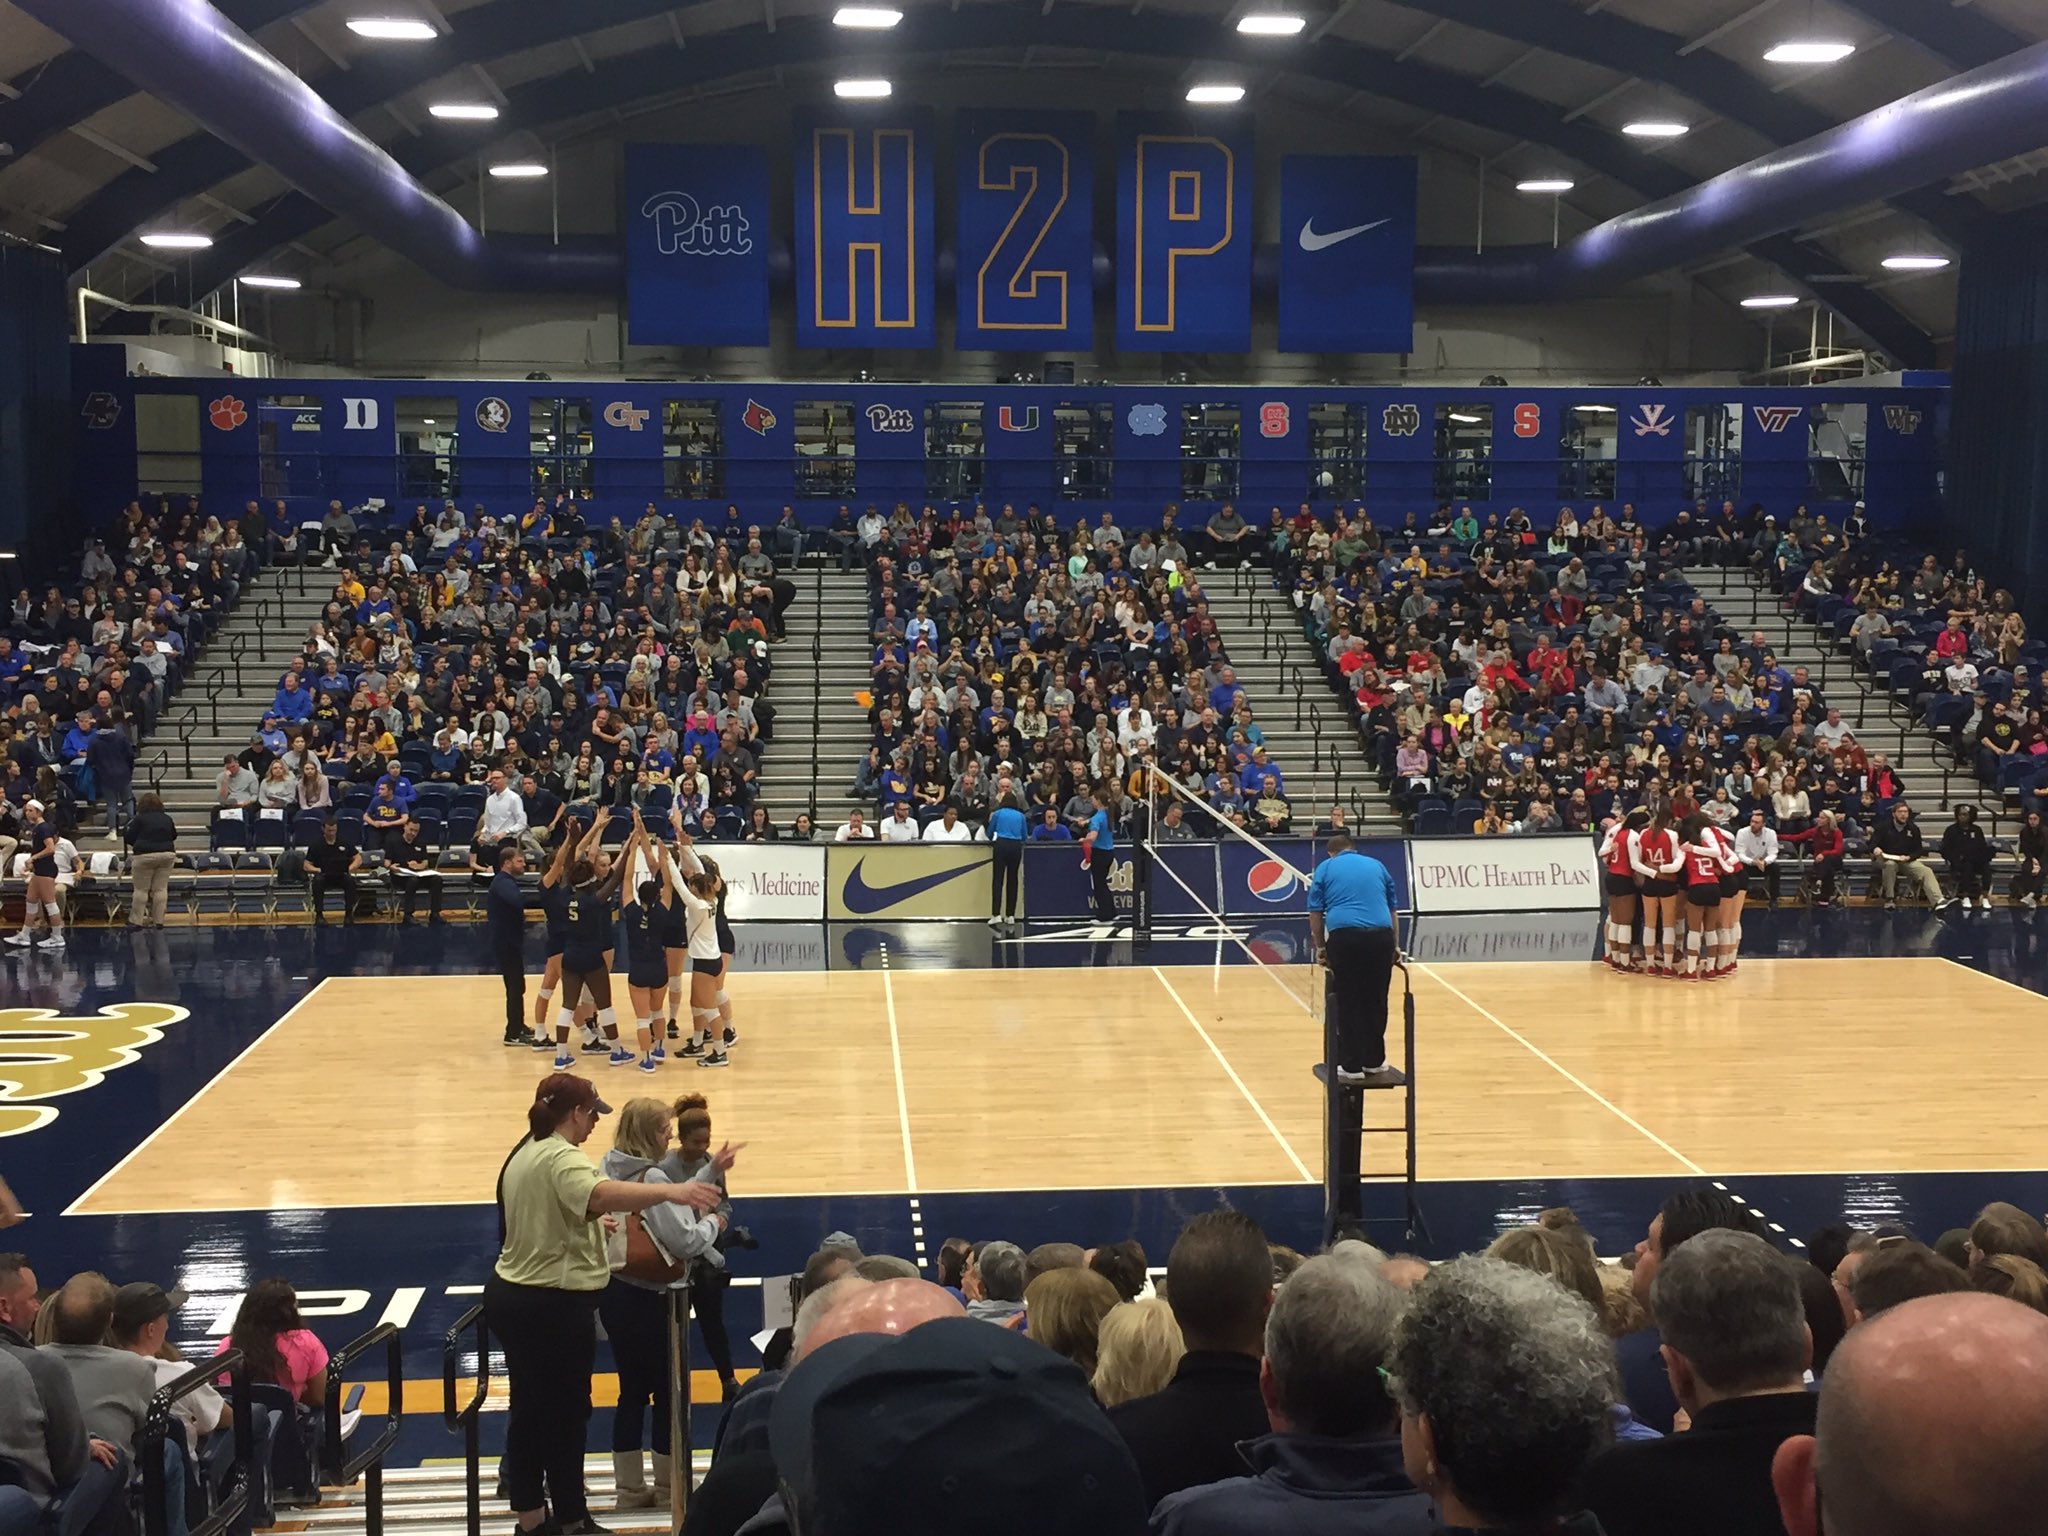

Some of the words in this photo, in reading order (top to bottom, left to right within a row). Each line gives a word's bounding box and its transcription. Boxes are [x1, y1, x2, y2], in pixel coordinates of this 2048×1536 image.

[641, 191, 753, 258] Pitt
[296, 414, 317, 424] ACC
[342, 398, 379, 430] D
[603, 401, 650, 432] GT
[866, 403, 914, 433] Pitt
[999, 405, 1040, 432] U
[1513, 403, 1541, 438] S
[1753, 406, 1804, 433] VT
[1882, 405, 1922, 435] WF
[1623, 779, 1640, 789] NH
[1646, 847, 1666, 866] 14
[1694, 857, 1715, 876] 12
[749, 871, 820, 897] Medicine
[1418, 863, 1480, 889] UPMC
[567, 908, 579, 922] 5
